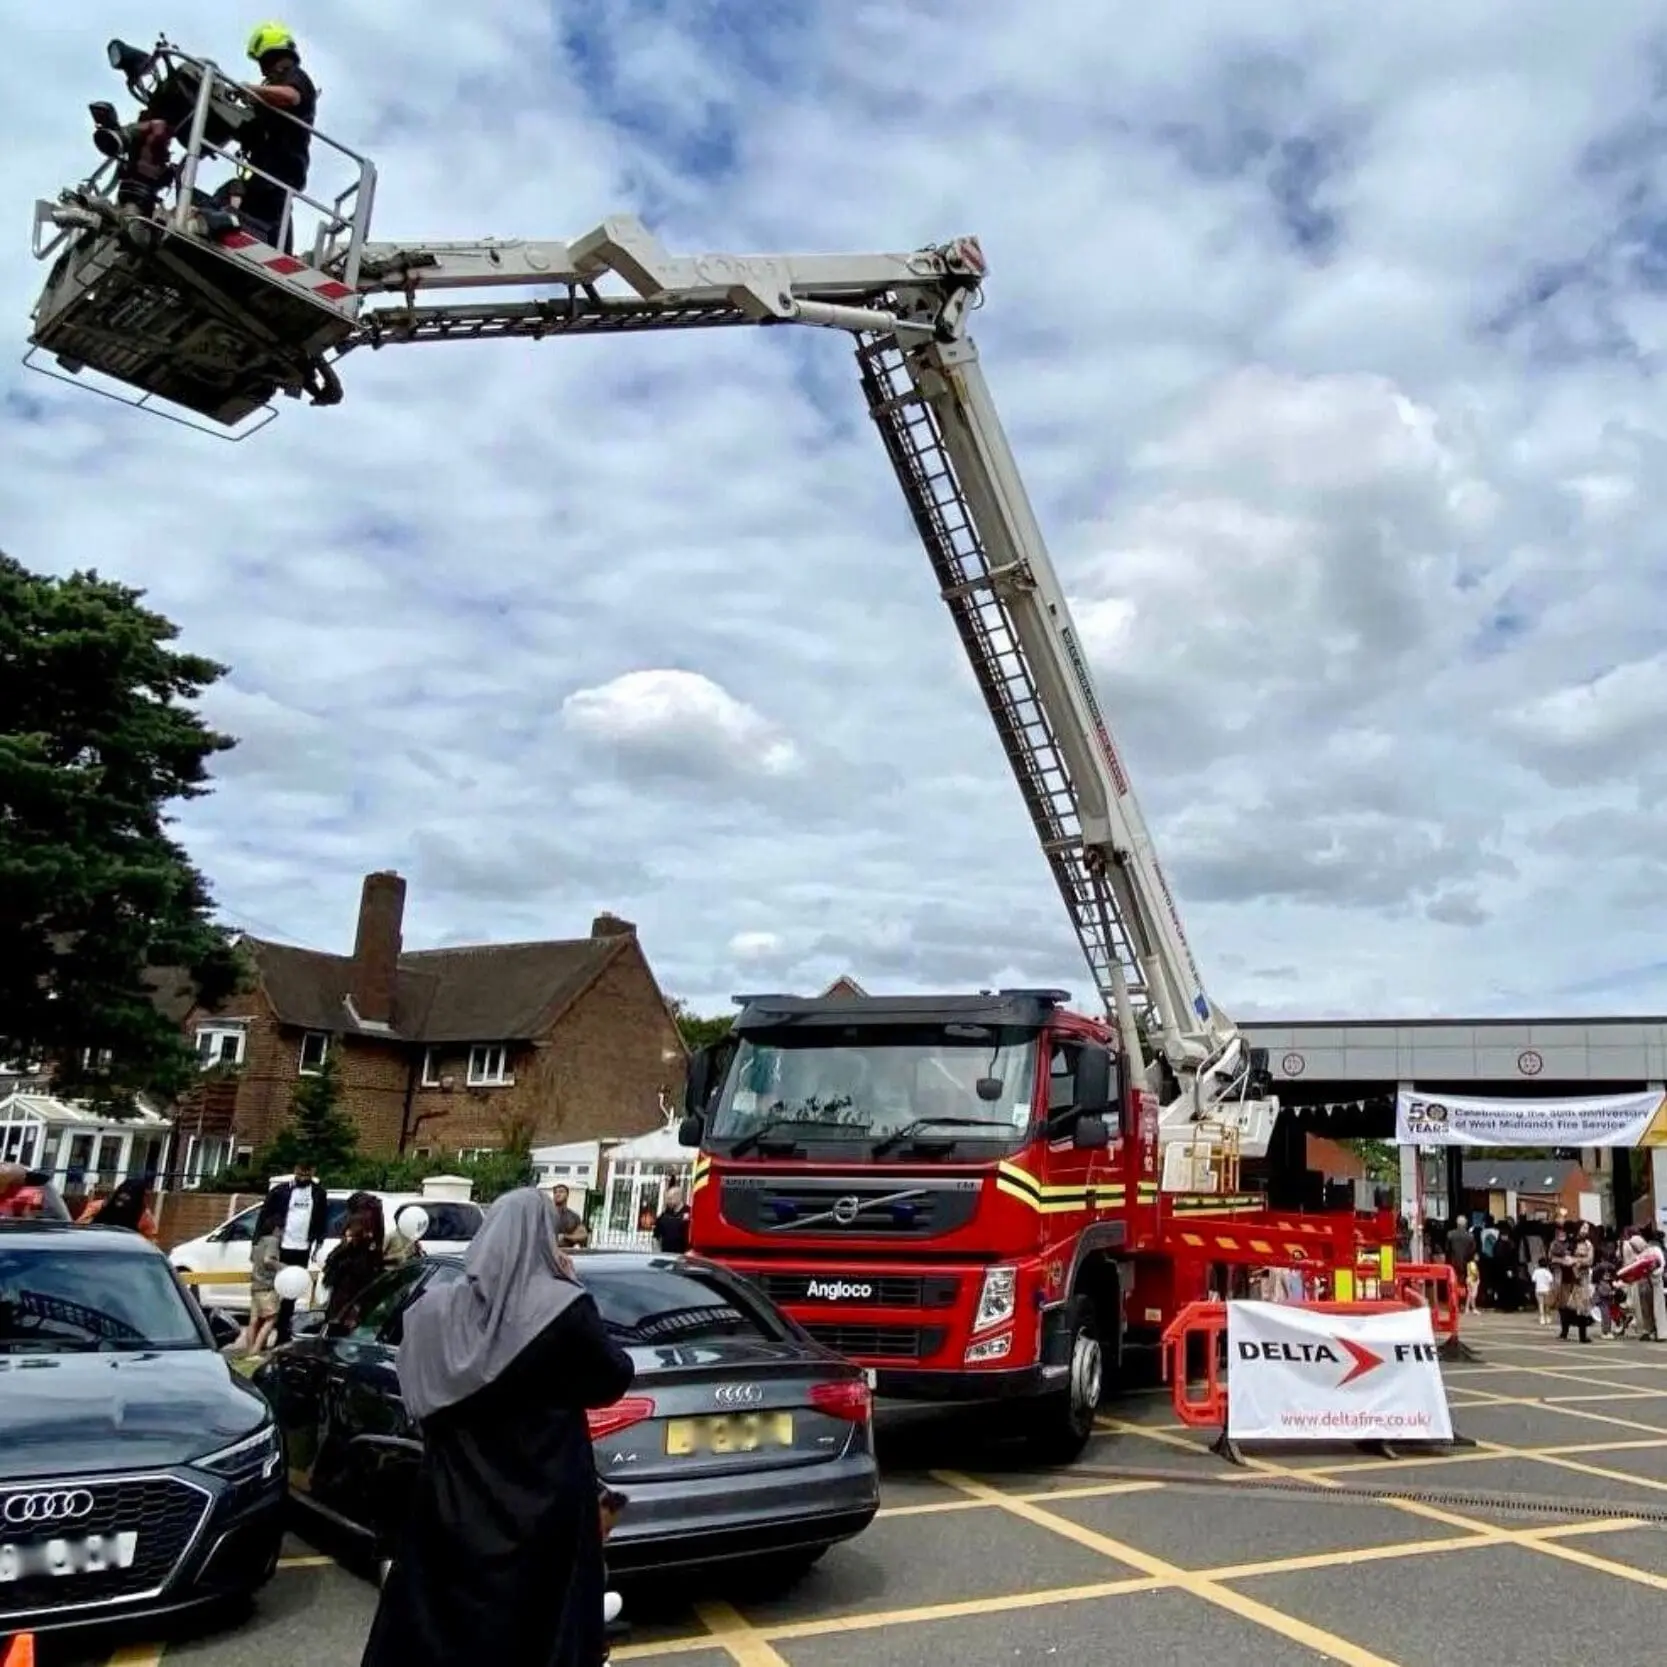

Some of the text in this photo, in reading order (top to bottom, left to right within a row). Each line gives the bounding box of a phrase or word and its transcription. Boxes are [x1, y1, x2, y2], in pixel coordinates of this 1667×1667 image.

[1408, 1103, 1448, 1121] 50
[1455, 1108, 1524, 1119] Celebrating
[1579, 1108, 1648, 1118] anniversary
[1407, 1123, 1449, 1133] YEARS
[1455, 1119, 1626, 1129] of West Midlands Fire Service
[807, 1280, 872, 1300] Angloco
[1238, 1341, 1340, 1363] DELTA
[612, 1452, 636, 1464] A4
